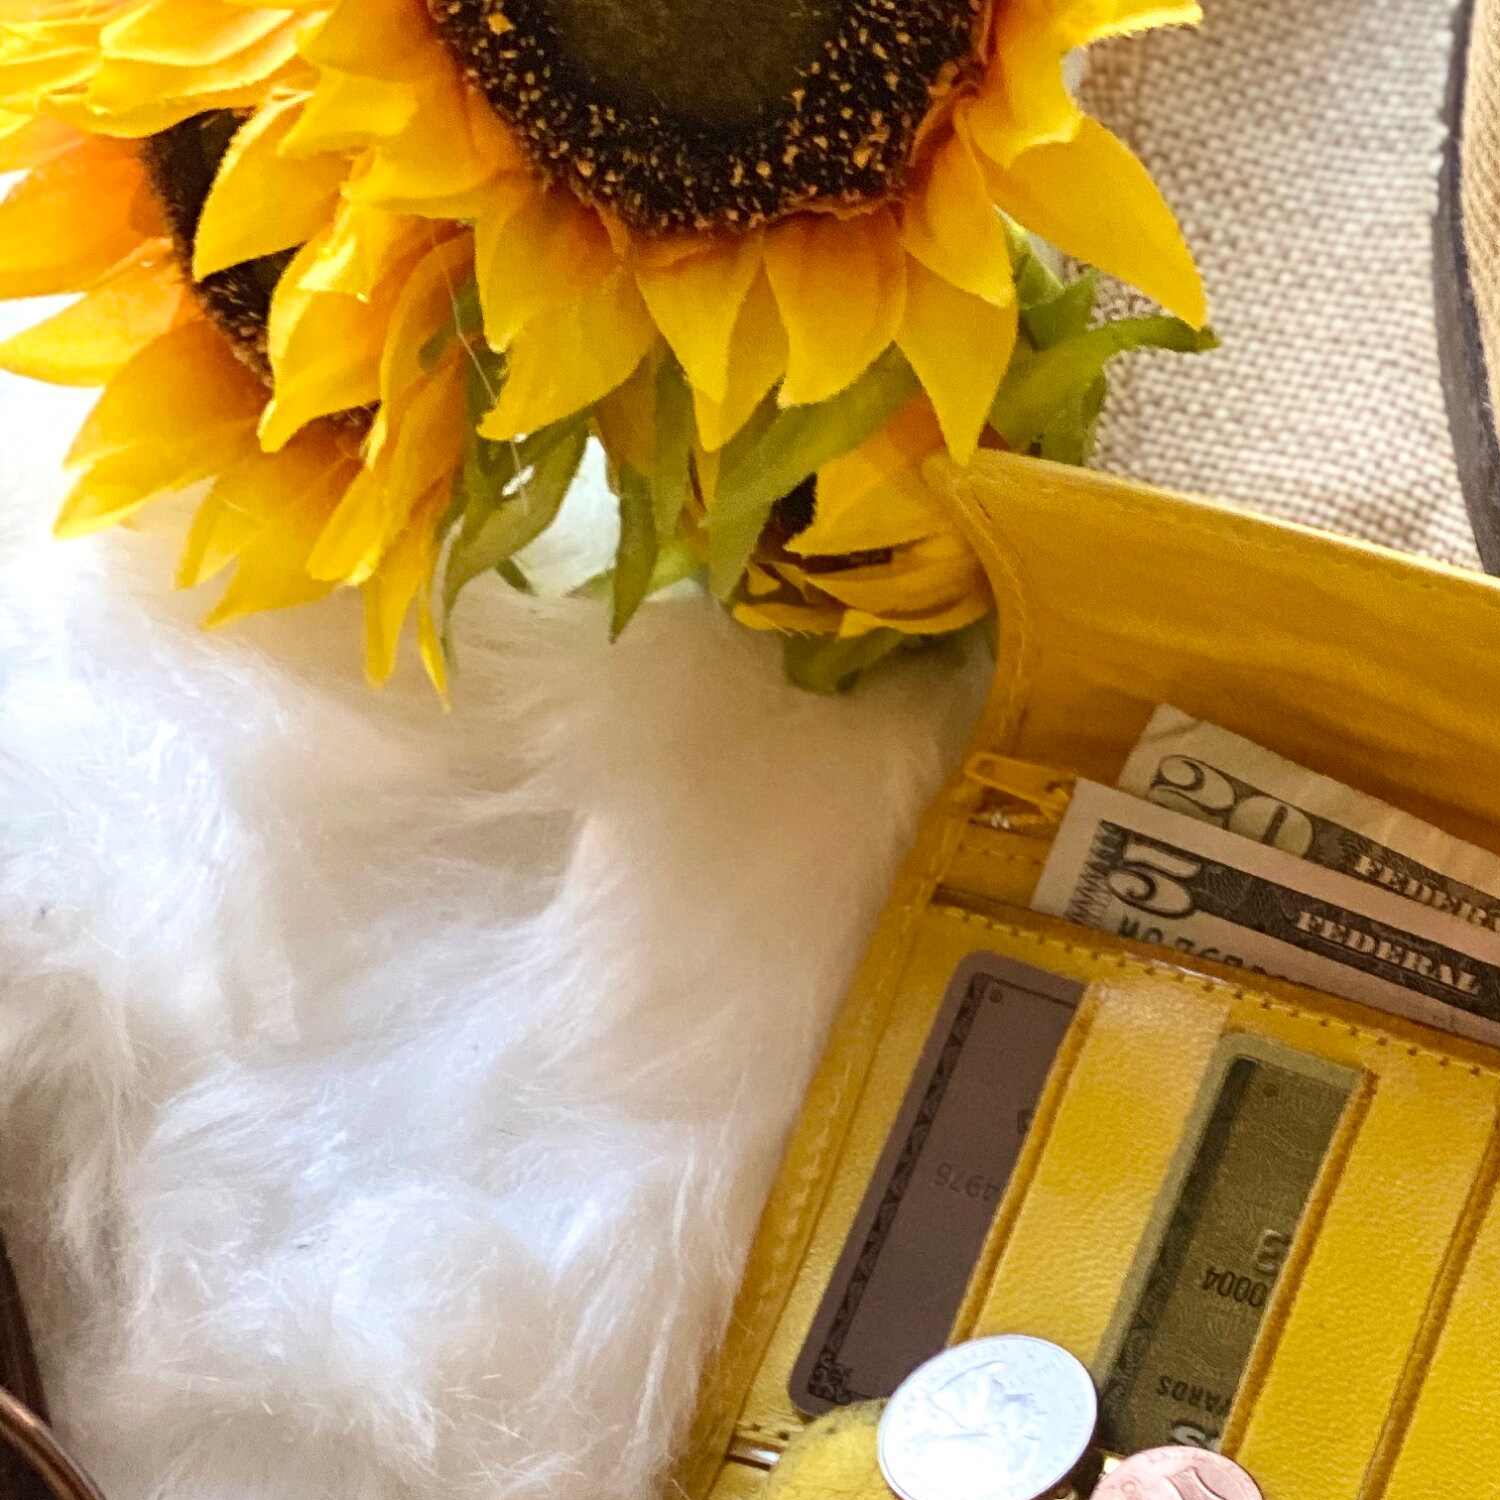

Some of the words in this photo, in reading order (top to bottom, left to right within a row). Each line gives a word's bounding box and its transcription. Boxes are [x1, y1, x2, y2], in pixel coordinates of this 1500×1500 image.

[1147, 754, 1314, 857] 20
[1105, 834, 1201, 920] 5
[1297, 911, 1479, 996] FEDERAL
[1202, 1265, 1269, 1308] 0004
